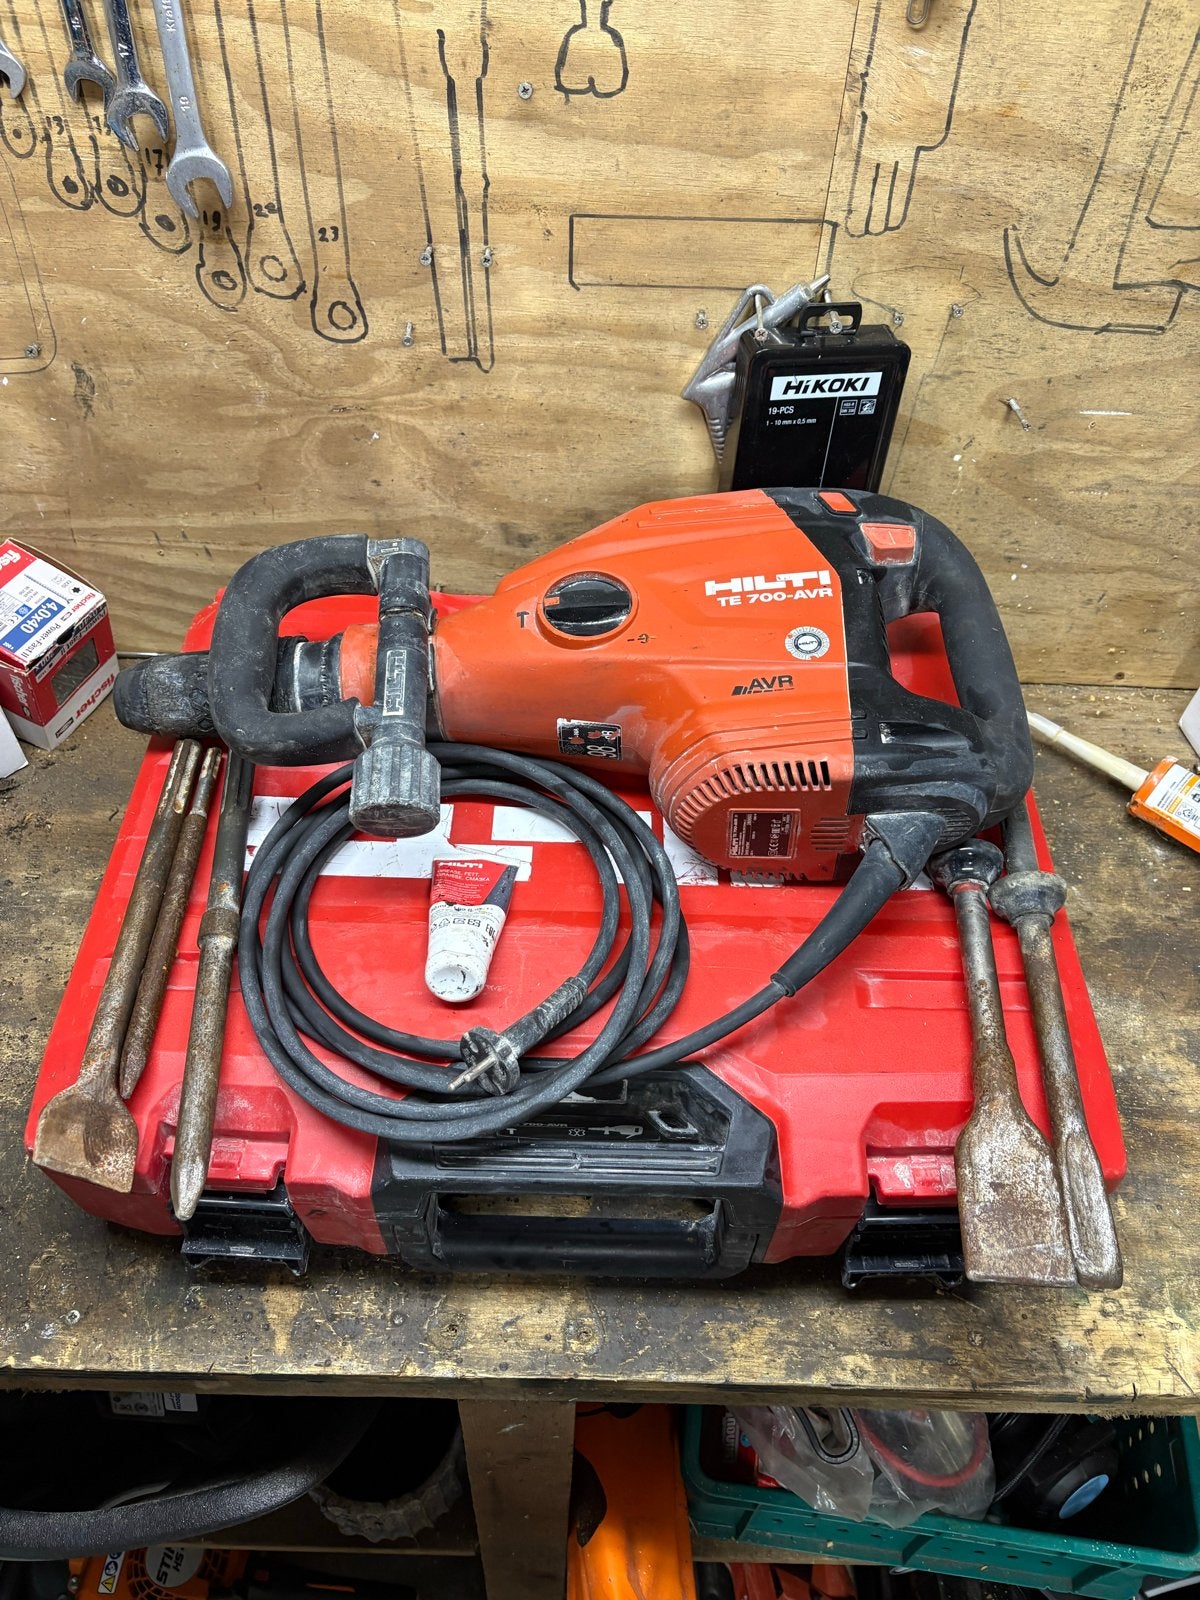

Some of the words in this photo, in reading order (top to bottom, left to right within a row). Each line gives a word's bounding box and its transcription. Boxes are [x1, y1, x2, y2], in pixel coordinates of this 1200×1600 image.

[118, 43, 132, 59] 17
[145, 147, 164, 176] 17
[203, 210, 221, 232] 19
[318, 225, 339, 242] 23
[782, 377, 871, 395] HiKOKI
[768, 406, 795, 415] 19-PCS
[705, 570, 831, 596] HILTI
[72, 592, 96, 613] fischer
[717, 595, 742, 607] TE
[746, 588, 833, 604] 700-AVR
[20, 601, 58, 634] 4,0x40
[26, 622, 61, 654] Power-Fast
[384, 652, 405, 713] HILTI
[749, 675, 794, 690] AVR
[75, 674, 115, 719] fischer
[586, 745, 617, 758] 98
